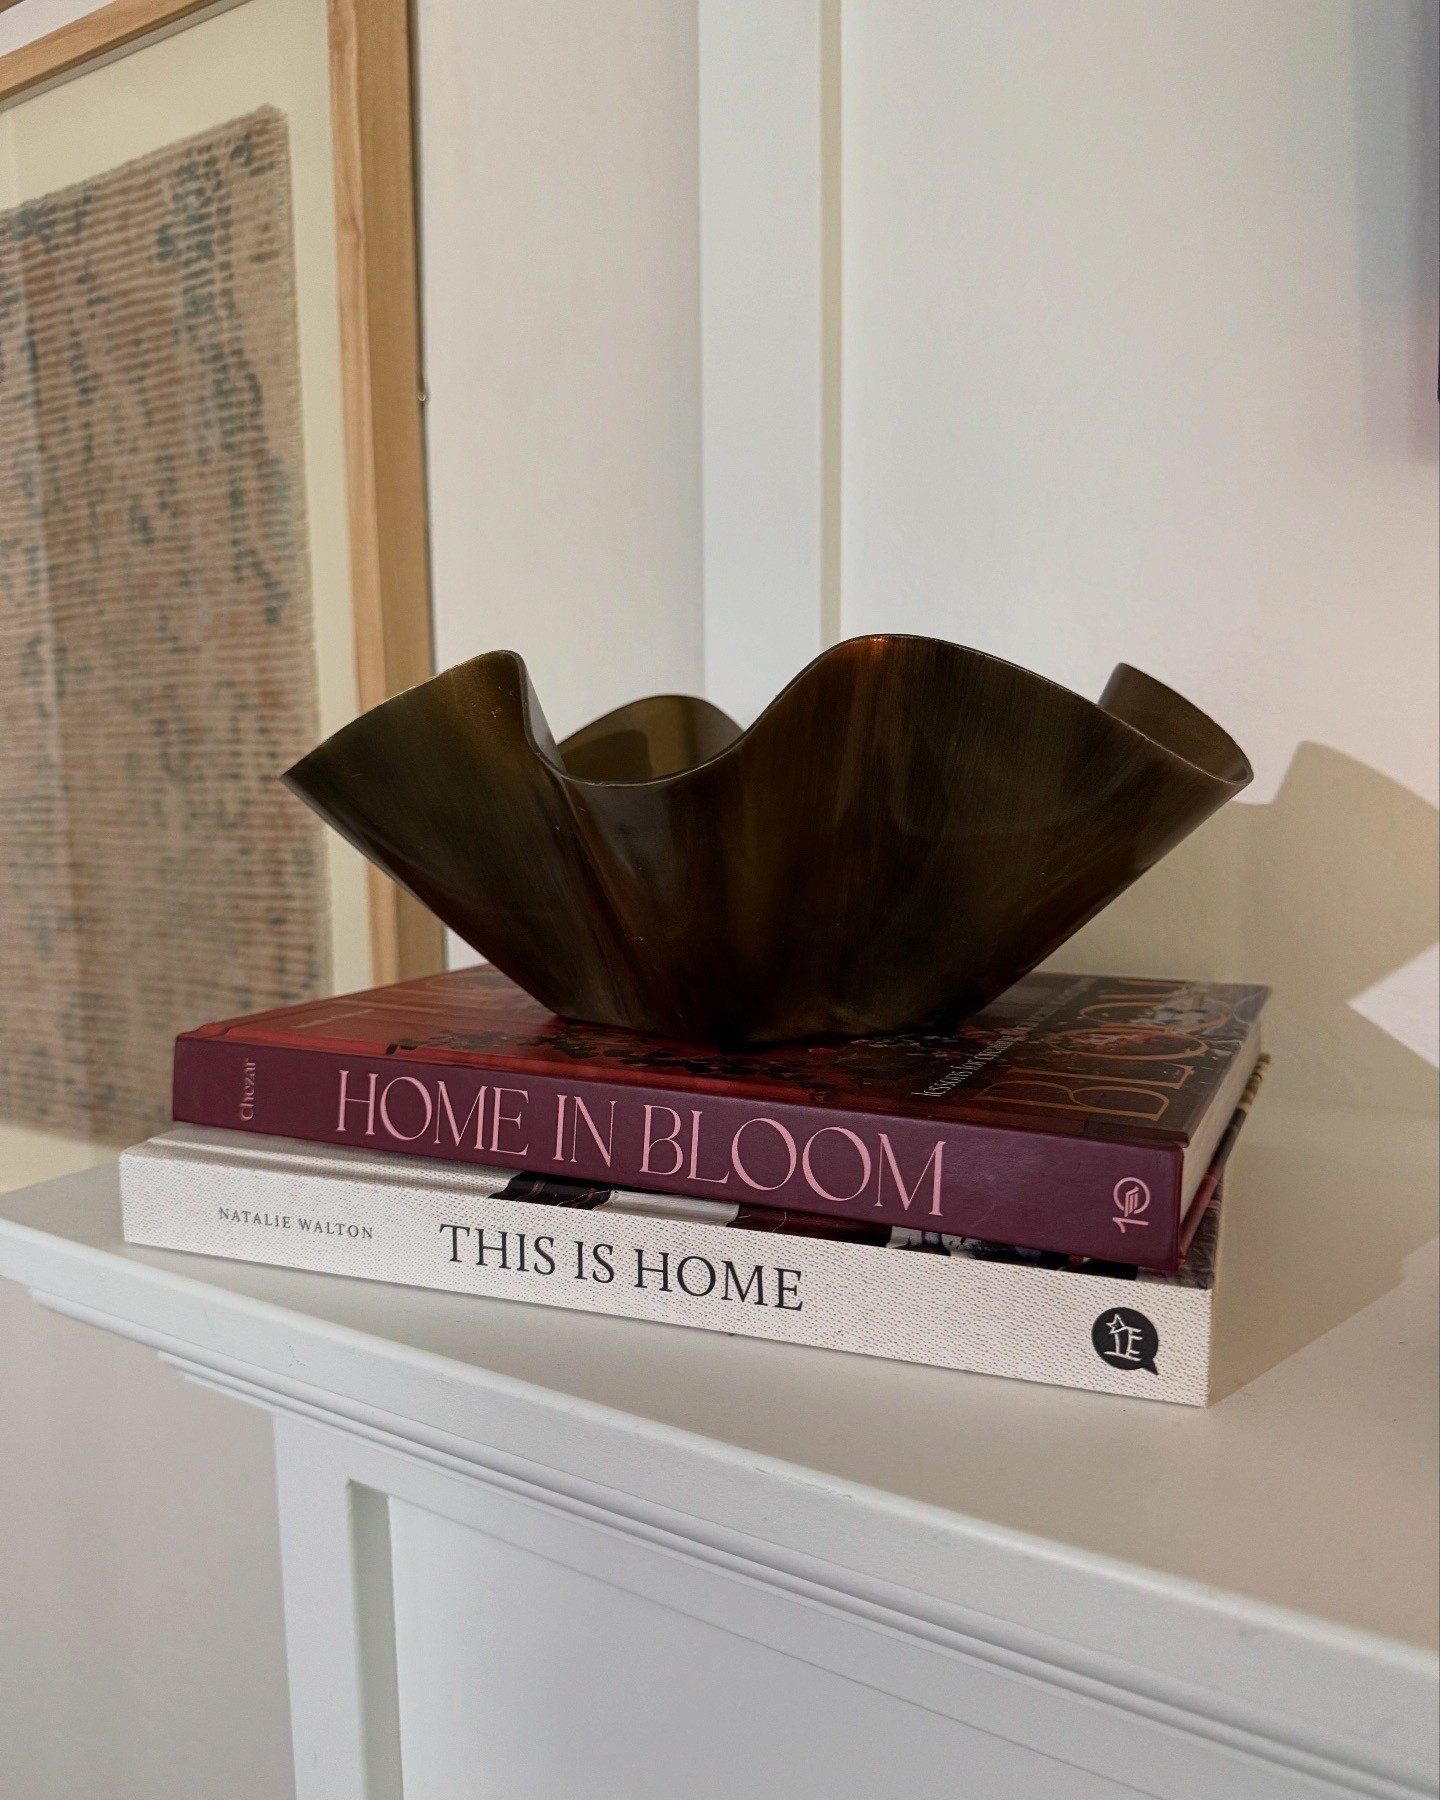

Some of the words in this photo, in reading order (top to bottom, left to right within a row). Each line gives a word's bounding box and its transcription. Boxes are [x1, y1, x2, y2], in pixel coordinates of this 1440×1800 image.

[240, 1058, 256, 1120] Chezar
[910, 1070, 973, 1097] lessons
[335, 1069, 530, 1156] HOME
[552, 1094, 617, 1168] IN
[640, 1104, 947, 1217] BLOOM
[218, 1206, 292, 1230] NATALIE
[297, 1217, 374, 1240] WALTON
[438, 1223, 556, 1276] THIS
[573, 1240, 615, 1284] IS
[633, 1248, 804, 1312] HOME
